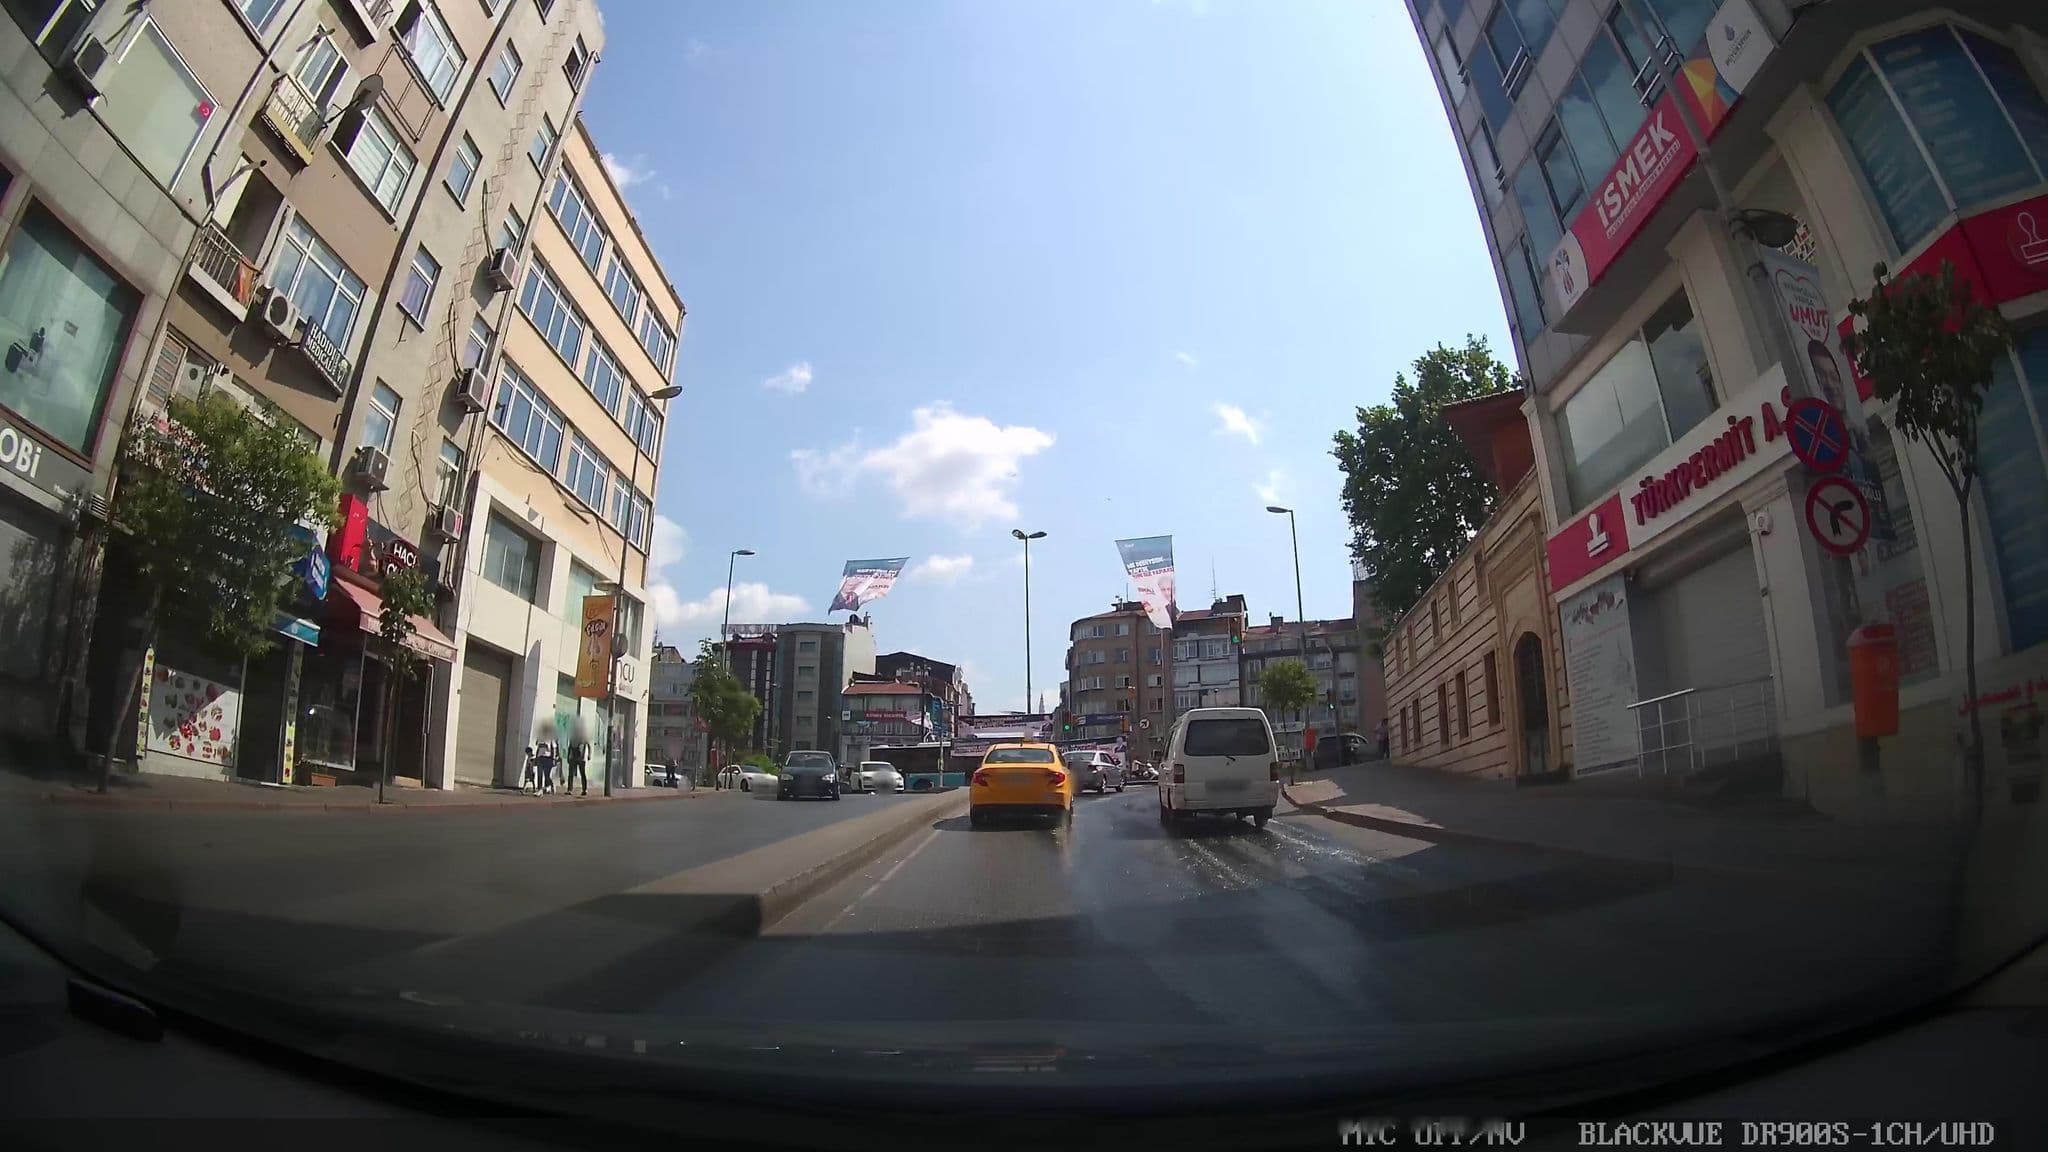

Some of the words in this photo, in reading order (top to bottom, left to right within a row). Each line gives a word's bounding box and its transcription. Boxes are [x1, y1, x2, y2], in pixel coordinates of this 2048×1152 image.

[1789, 303, 1829, 329] UMUT
[306, 335, 334, 372] MEDICAL
[1630, 415, 1757, 526] TÜRKPERMİT
